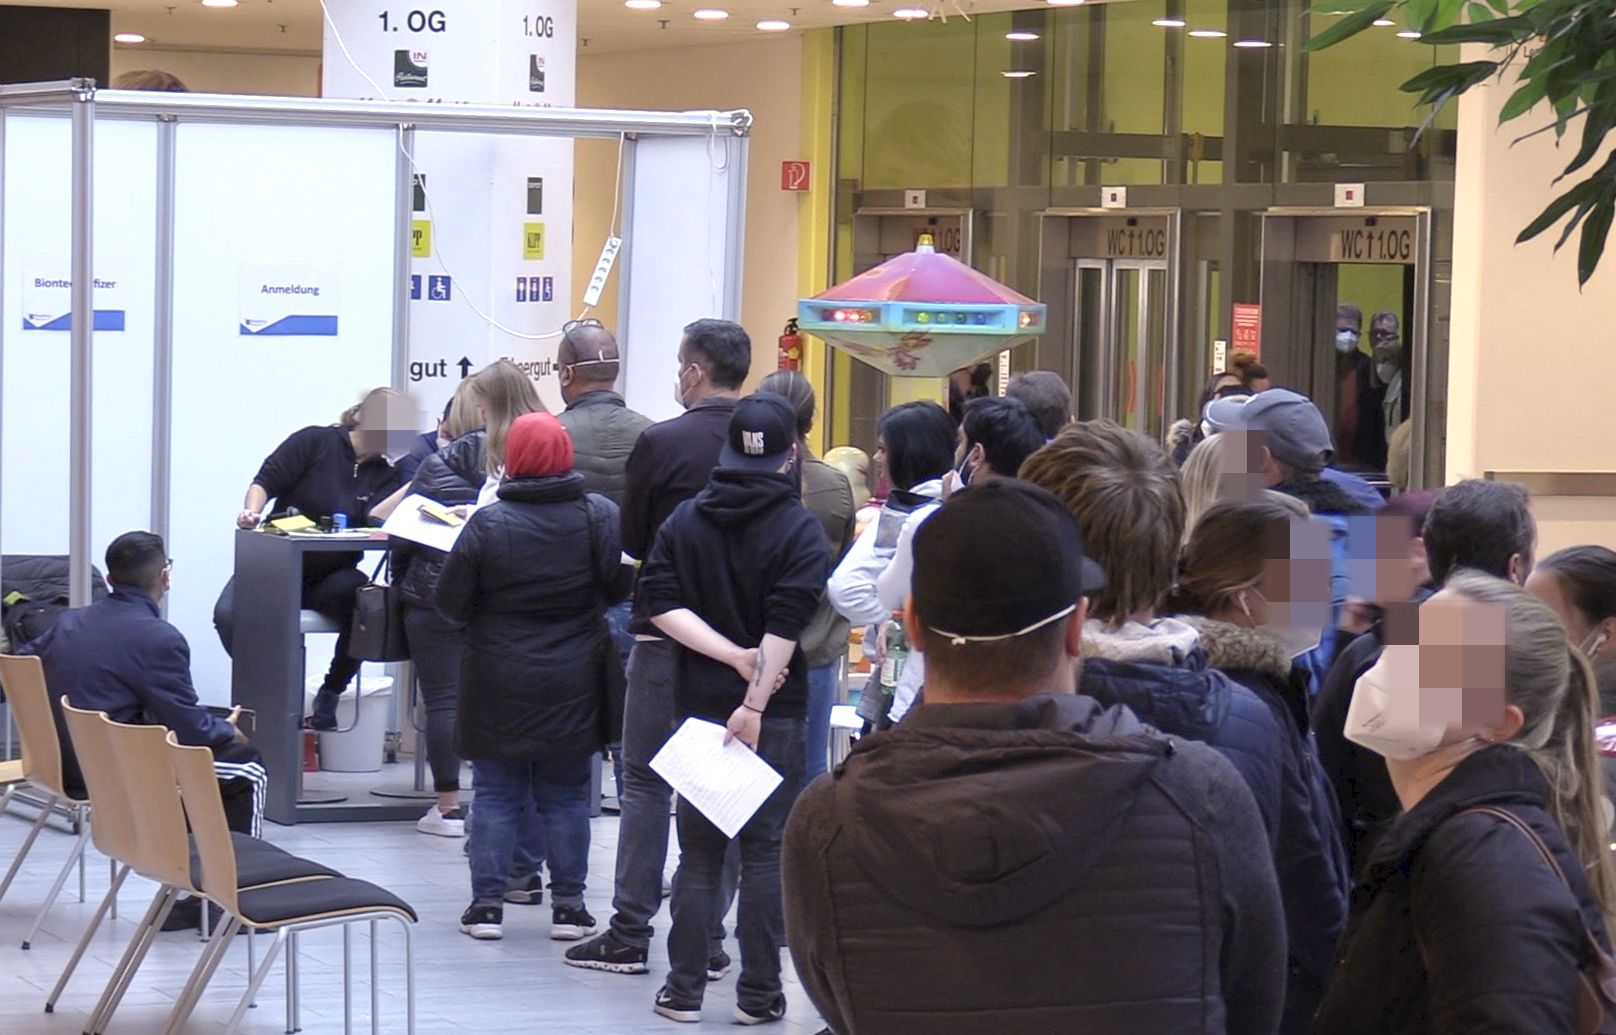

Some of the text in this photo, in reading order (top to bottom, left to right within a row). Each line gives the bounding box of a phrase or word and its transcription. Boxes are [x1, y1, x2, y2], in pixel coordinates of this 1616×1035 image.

[378, 9, 446, 33] 1. OG
[523, 14, 553, 39] 1. OG
[413, 51, 427, 60] IN
[1341, 229, 1411, 260] WC 1.OG
[260, 284, 321, 297] Anmeldung
